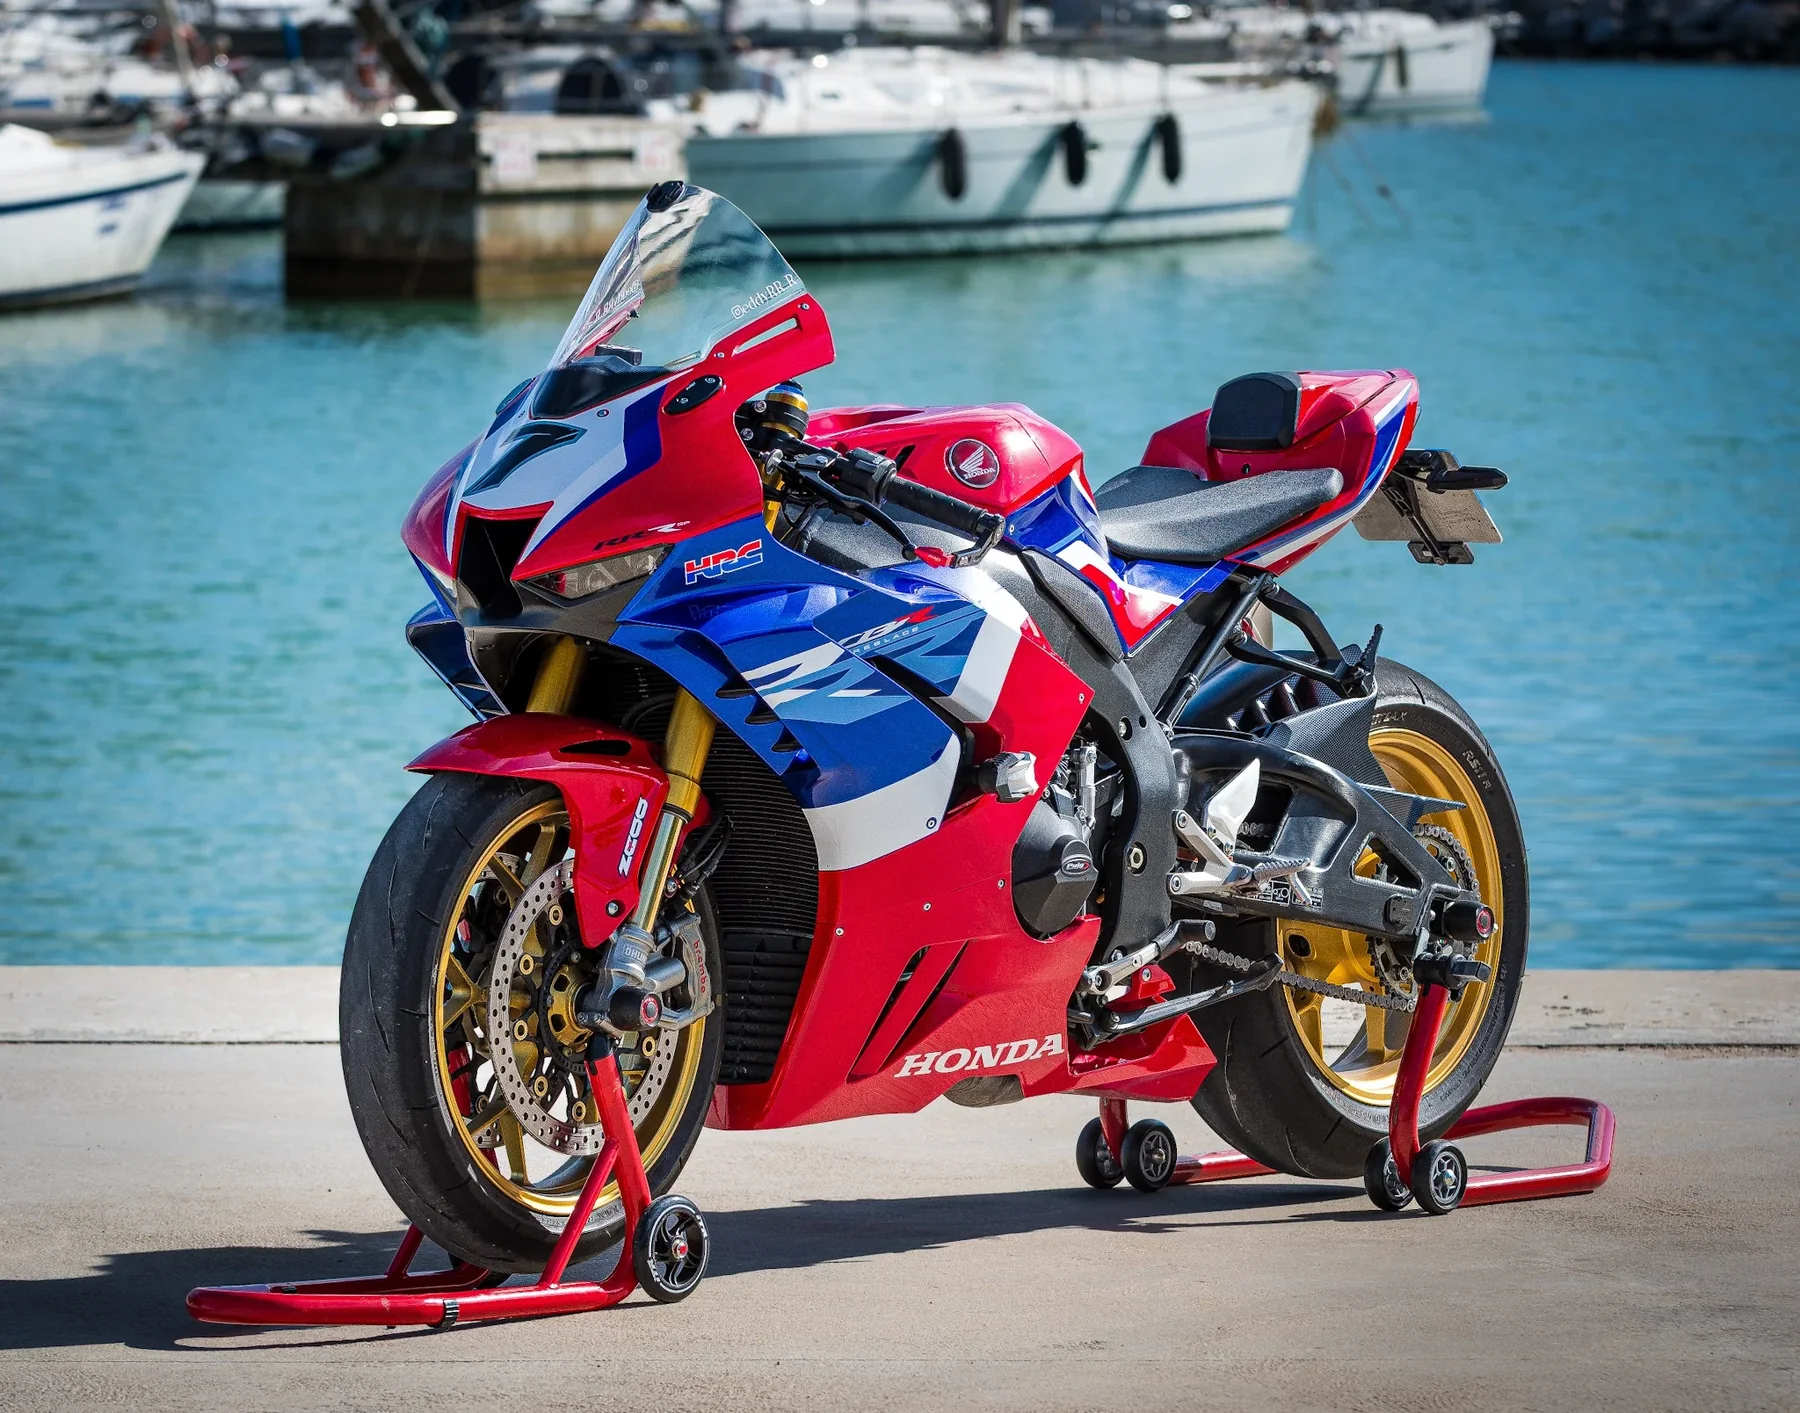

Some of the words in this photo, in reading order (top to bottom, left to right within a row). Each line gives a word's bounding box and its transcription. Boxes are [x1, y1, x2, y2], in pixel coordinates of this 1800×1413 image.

[963, 467, 997, 480] HONDA
[684, 538, 763, 586] HRC
[693, 940, 707, 993] brembo
[893, 1033, 1065, 1078] HONDA
